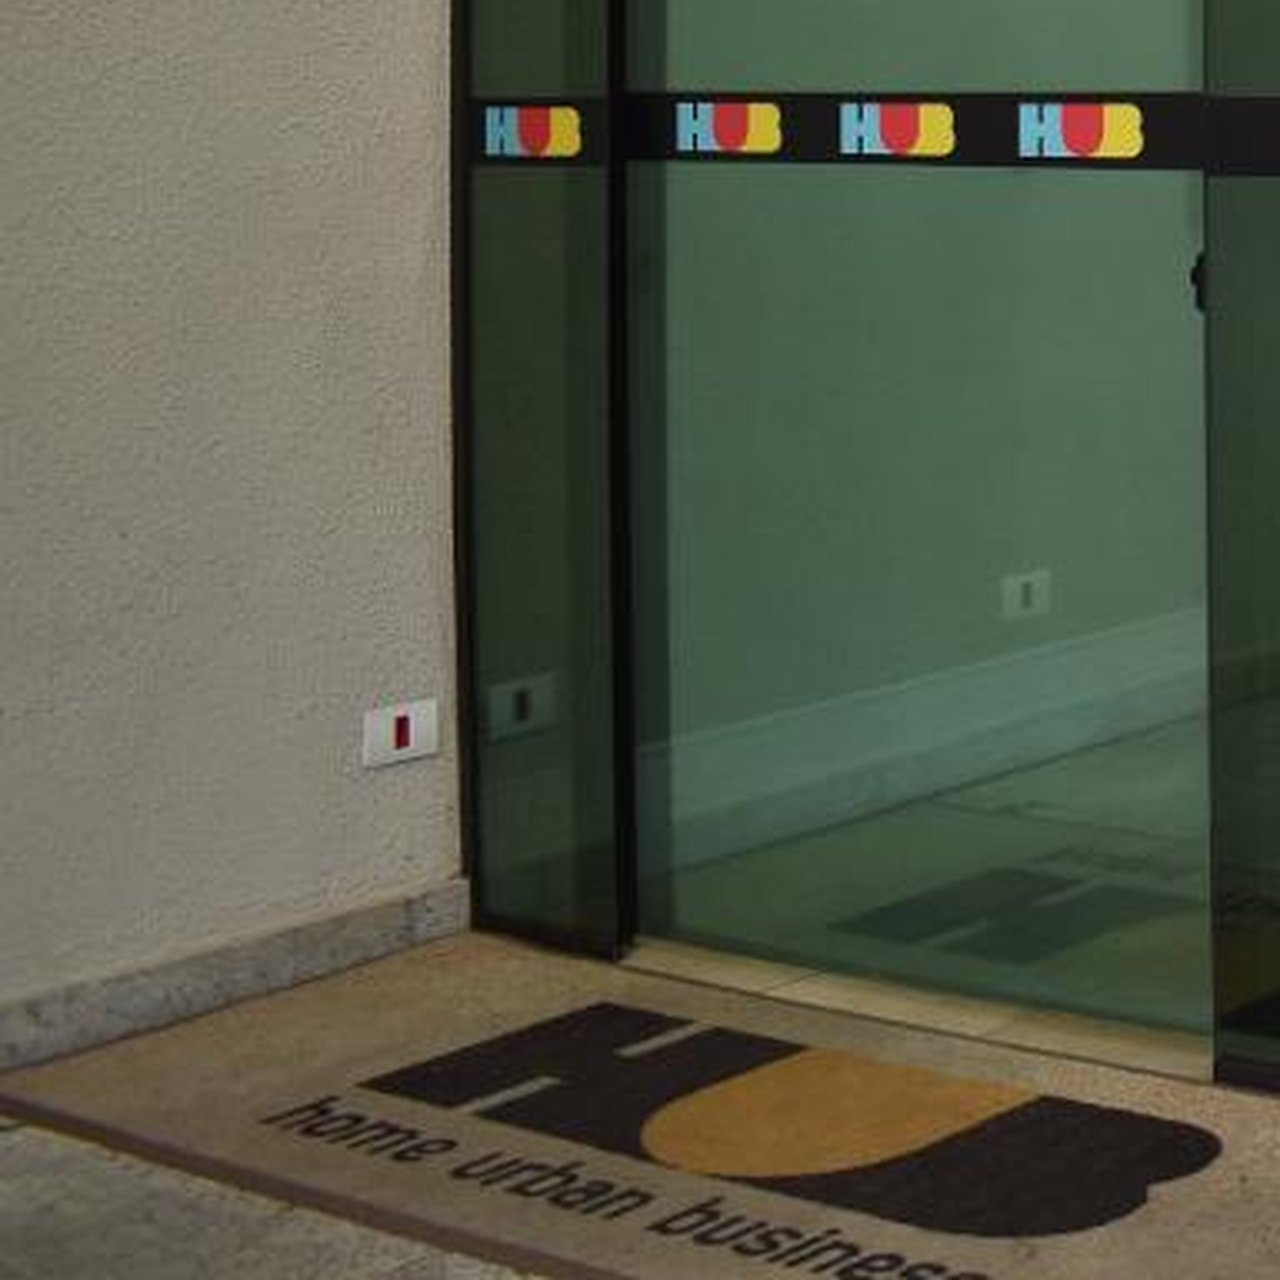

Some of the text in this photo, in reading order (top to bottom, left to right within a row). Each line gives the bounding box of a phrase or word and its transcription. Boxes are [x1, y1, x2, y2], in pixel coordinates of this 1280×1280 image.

[676, 102, 782, 154] HUB
[839, 102, 955, 158] HUB
[1018, 103, 1143, 158] HUB
[263, 1094, 458, 1163] home
[448, 1149, 656, 1221] urban
